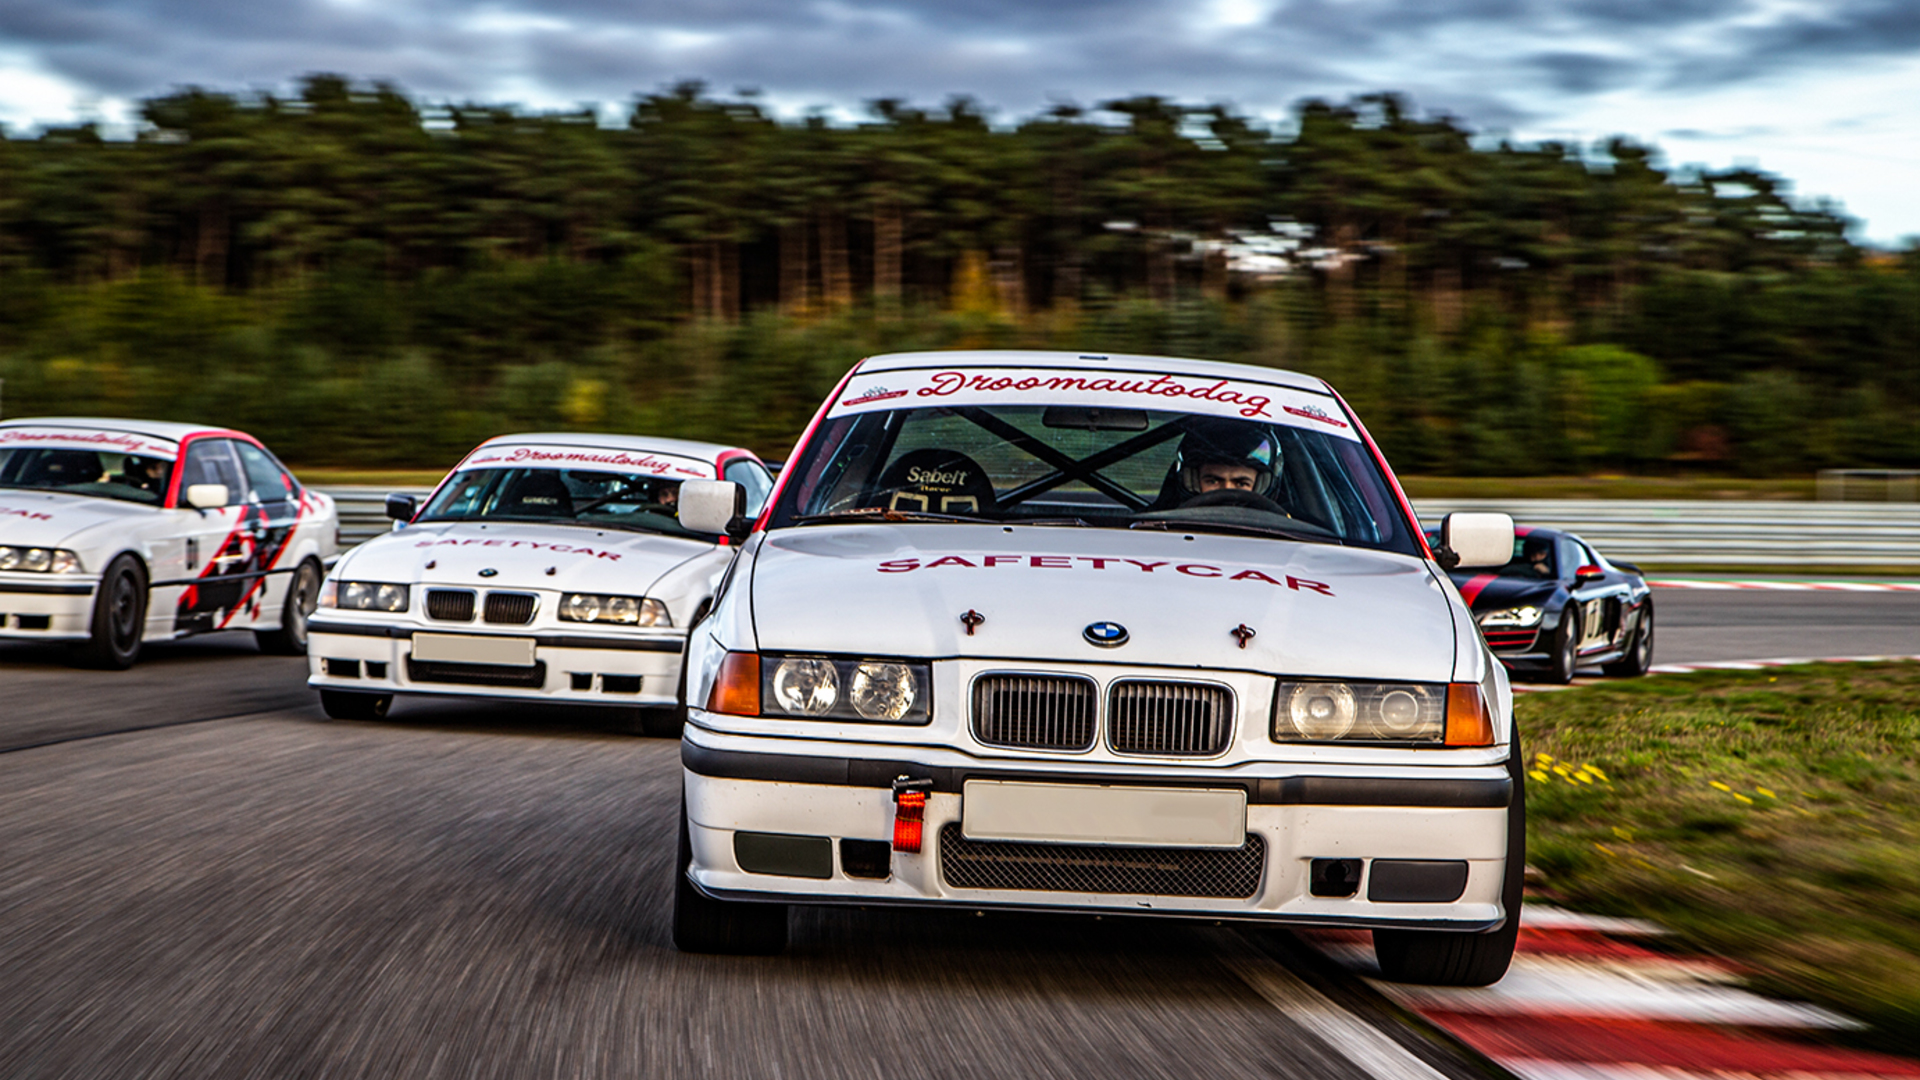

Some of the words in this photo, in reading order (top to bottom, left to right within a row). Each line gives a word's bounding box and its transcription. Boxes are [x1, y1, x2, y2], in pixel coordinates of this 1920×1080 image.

[916, 371, 1272, 419] Droomautodag
[504, 448, 671, 474] Droomautodag
[907, 466, 968, 486] Sabelt
[415, 539, 622, 561] SAFETYCAR
[876, 555, 1336, 598] SAFETYCAR
